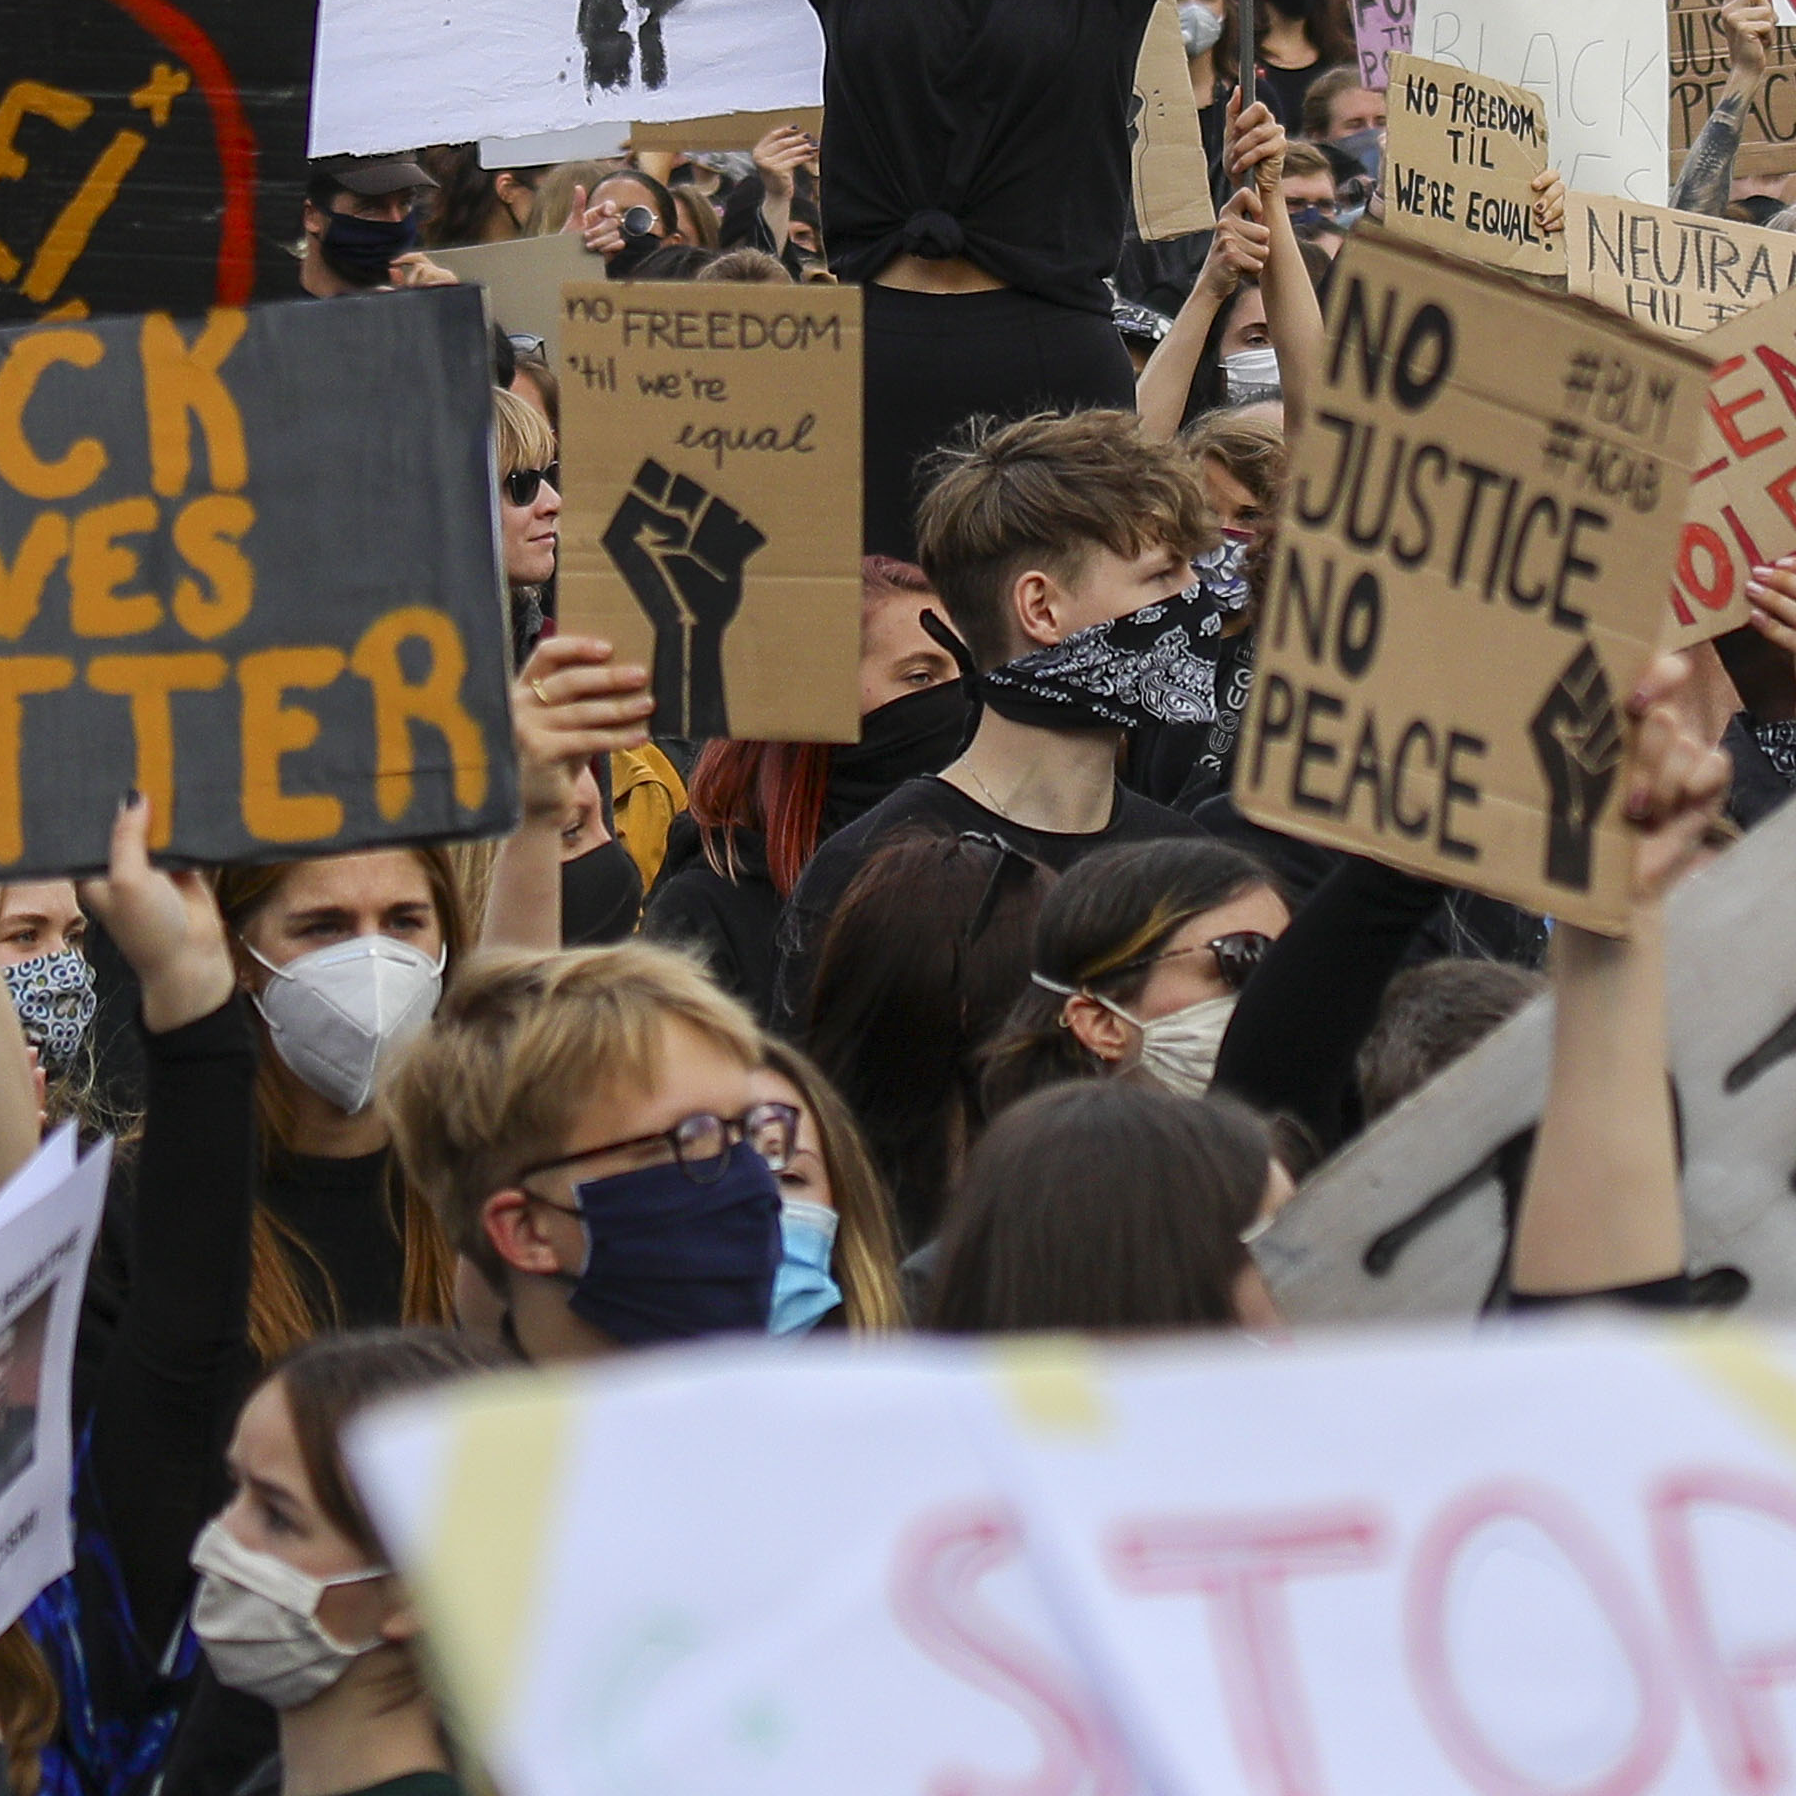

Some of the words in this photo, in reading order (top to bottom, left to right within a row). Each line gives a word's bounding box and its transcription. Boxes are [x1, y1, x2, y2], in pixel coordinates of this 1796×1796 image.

[1404, 73, 1440, 115] NO
[1449, 81, 1540, 149] FREEDOM
[1393, 163, 1458, 222] WE'RE
[1465, 190, 1555, 254] EQUAL!
[564, 292, 614, 323] no
[620, 308, 843, 351] FREEDOM
[1325, 276, 1454, 408] NO
[636, 369, 727, 402] we're
[674, 413, 817, 469] equal
[1292, 407, 1612, 633] JUSTICE
[1277, 543, 1387, 681] NO
[1248, 669, 1489, 864] PEACE
